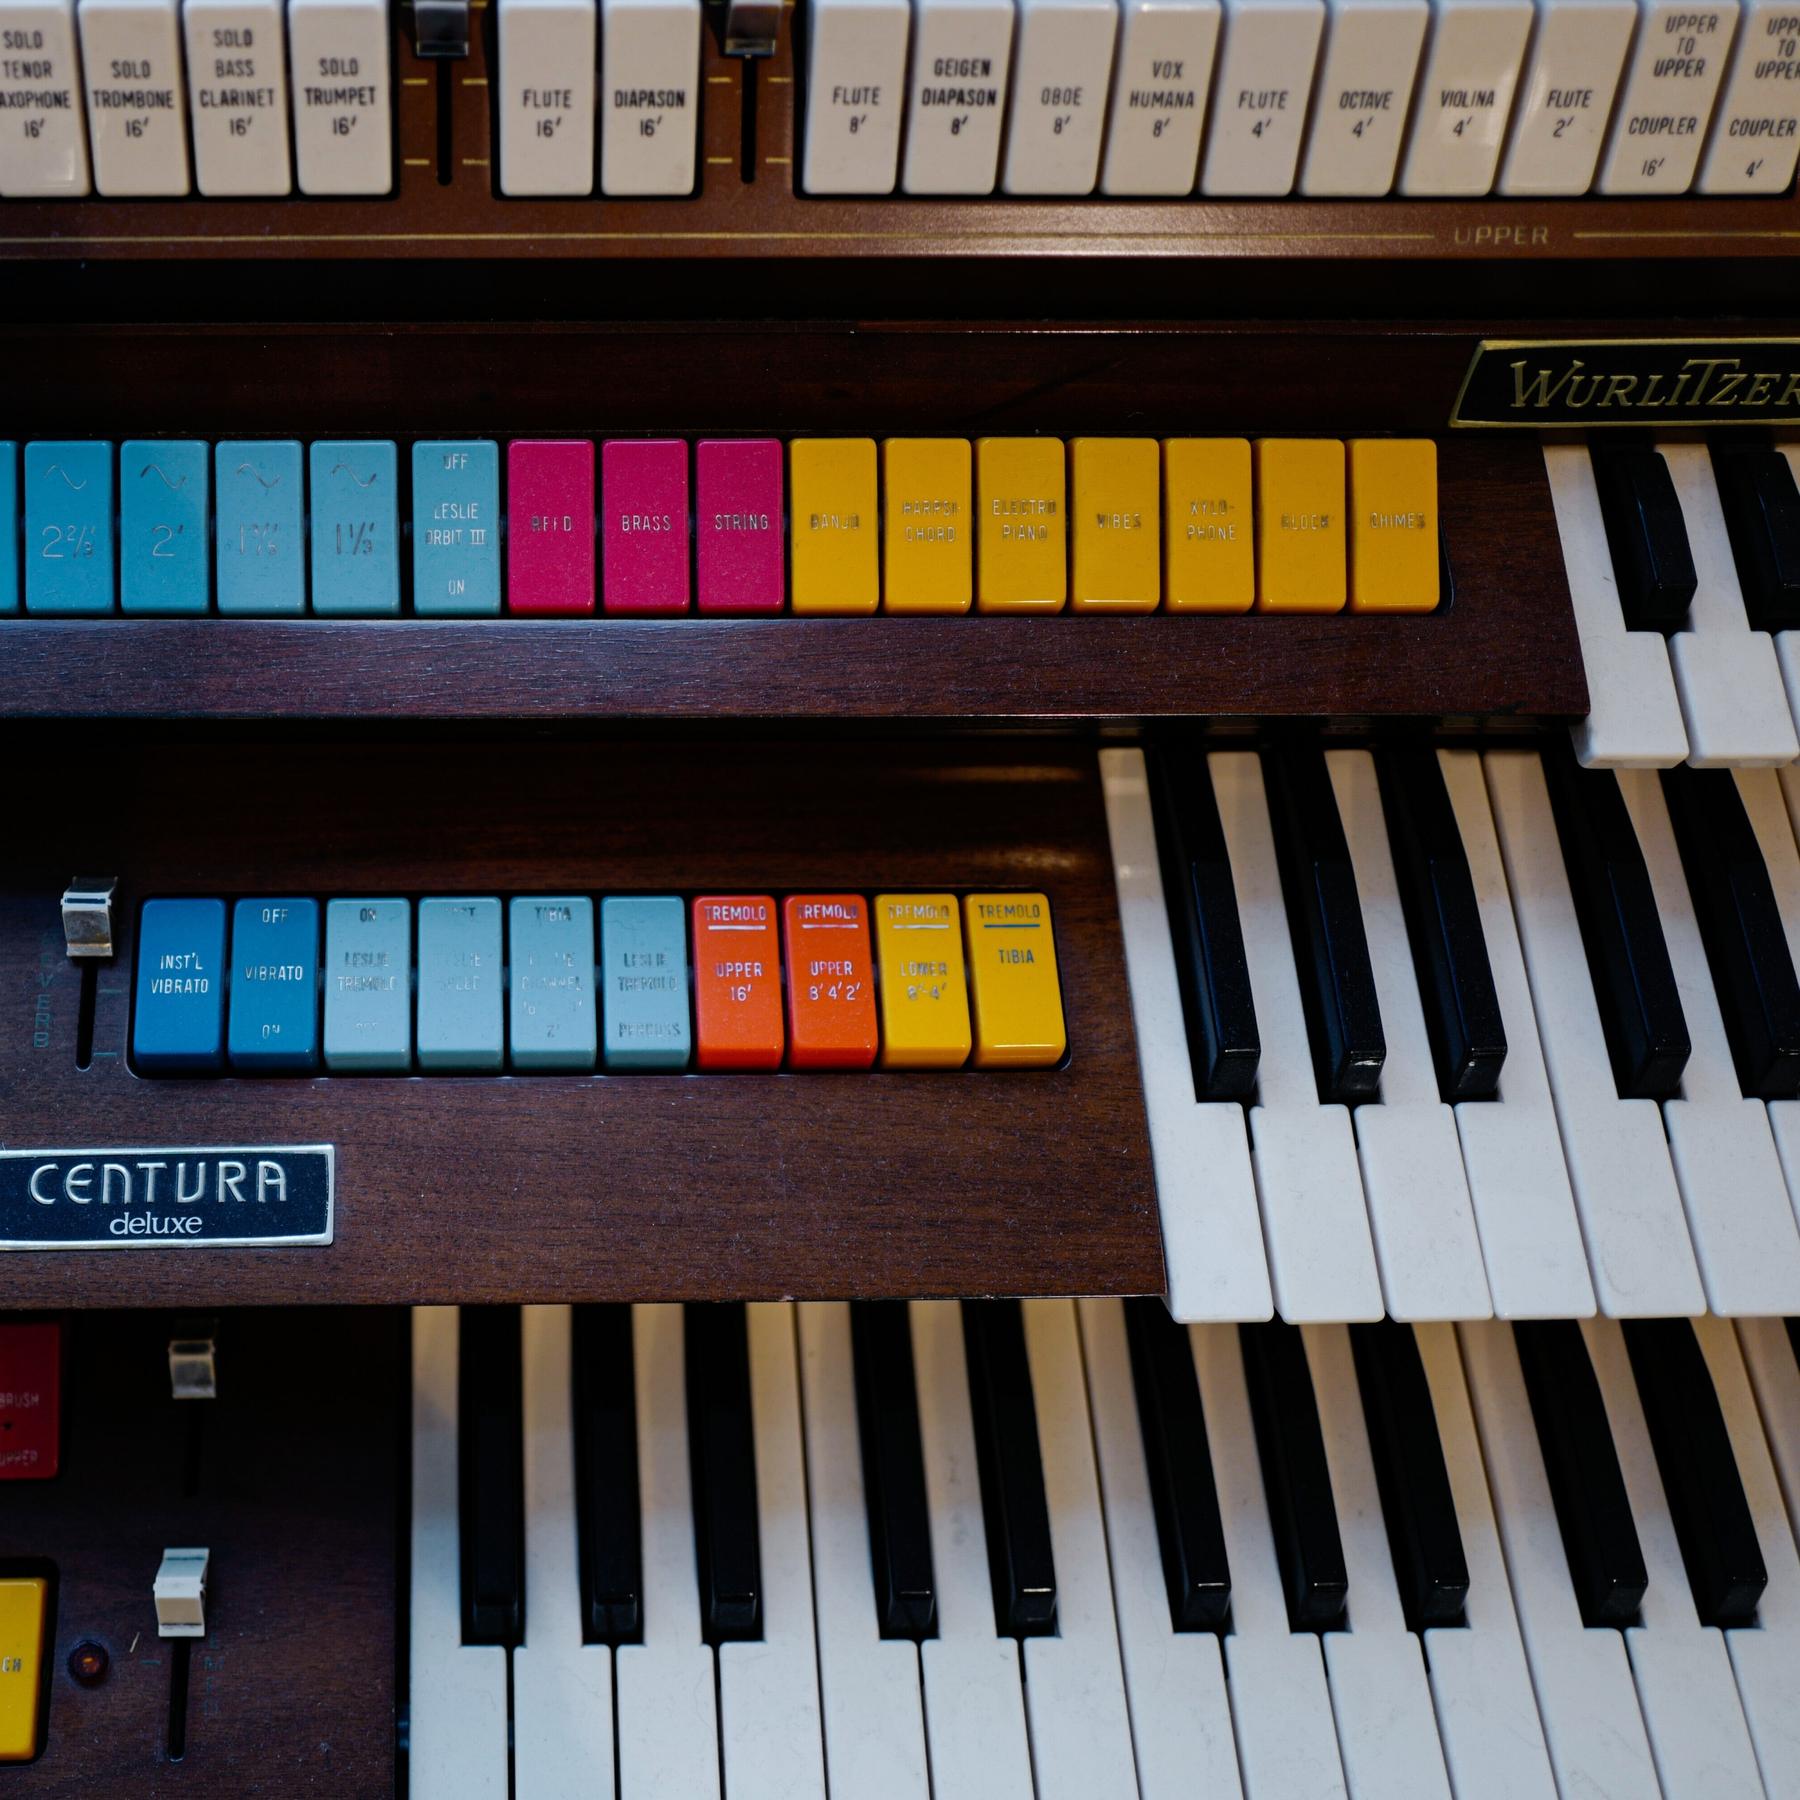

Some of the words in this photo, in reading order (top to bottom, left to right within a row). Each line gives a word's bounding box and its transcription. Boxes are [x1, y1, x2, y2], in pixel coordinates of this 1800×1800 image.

[1665, 14, 1719, 33] UPPER
[4, 30, 43, 49] SOLO
[213, 28, 253, 47] SOLO
[1678, 37, 1695, 55] TO
[1778, 39, 1795, 57] TO
[3, 60, 53, 78] TENOR
[111, 60, 151, 79] SOLO
[215, 59, 255, 78] BASS
[319, 57, 359, 76] SOLO
[933, 58, 991, 78] GEIGEN
[1152, 61, 1184, 80] VOX
[1653, 58, 1706, 77] UPPER
[93, 89, 174, 108] TROMBONE
[200, 88, 275, 107] CLARINET
[304, 86, 376, 106] TRUMPET
[522, 89, 572, 109] FLUTE
[614, 89, 686, 109] DIAPASON
[832, 86, 880, 106] FLUTE
[921, 87, 996, 107] DIAPASON
[1041, 87, 1083, 107] OBOE
[1130, 91, 1195, 109] HUMANA
[1238, 91, 1288, 110] FLUTE
[1339, 91, 1393, 110] OCTAVE
[1440, 89, 1495, 108] VIOLINA
[1547, 90, 1593, 109] FLUTE
[1628, 117, 1697, 136] COUPLER
[1729, 118, 1797, 137] COUPLER
[1454, 226, 1549, 245] UPPER
[434, 503, 479, 520] LESLIE
[993, 499, 1057, 516] ELECTRO
[622, 514, 672, 531] BRASS
[715, 513, 769, 531] STRING
[1096, 513, 1142, 529] VIBES
[1371, 512, 1426, 529] CHIMES
[425, 528, 462, 546] ORBIT
[469, 528, 486, 545] III
[905, 526, 956, 543] CHORD
[1002, 524, 1048, 541] PIANO
[447, 579, 465, 595] ON
[262, 908, 288, 924] OFF
[704, 905, 766, 921] TREMOLO
[797, 904, 859, 920] TREMOLO
[978, 904, 1040, 919] TREMOLO
[160, 952, 203, 970] INST'L
[998, 949, 1034, 964] TIBIA
[245, 966, 303, 981] VIBRATO
[716, 962, 762, 978] UPPER
[810, 961, 853, 976] UPPER
[899, 961, 947, 976] LOWER
[151, 978, 209, 994] VIBRATO
[28, 1160, 288, 1206] CENTURA
[109, 1211, 203, 1235] deluxe
